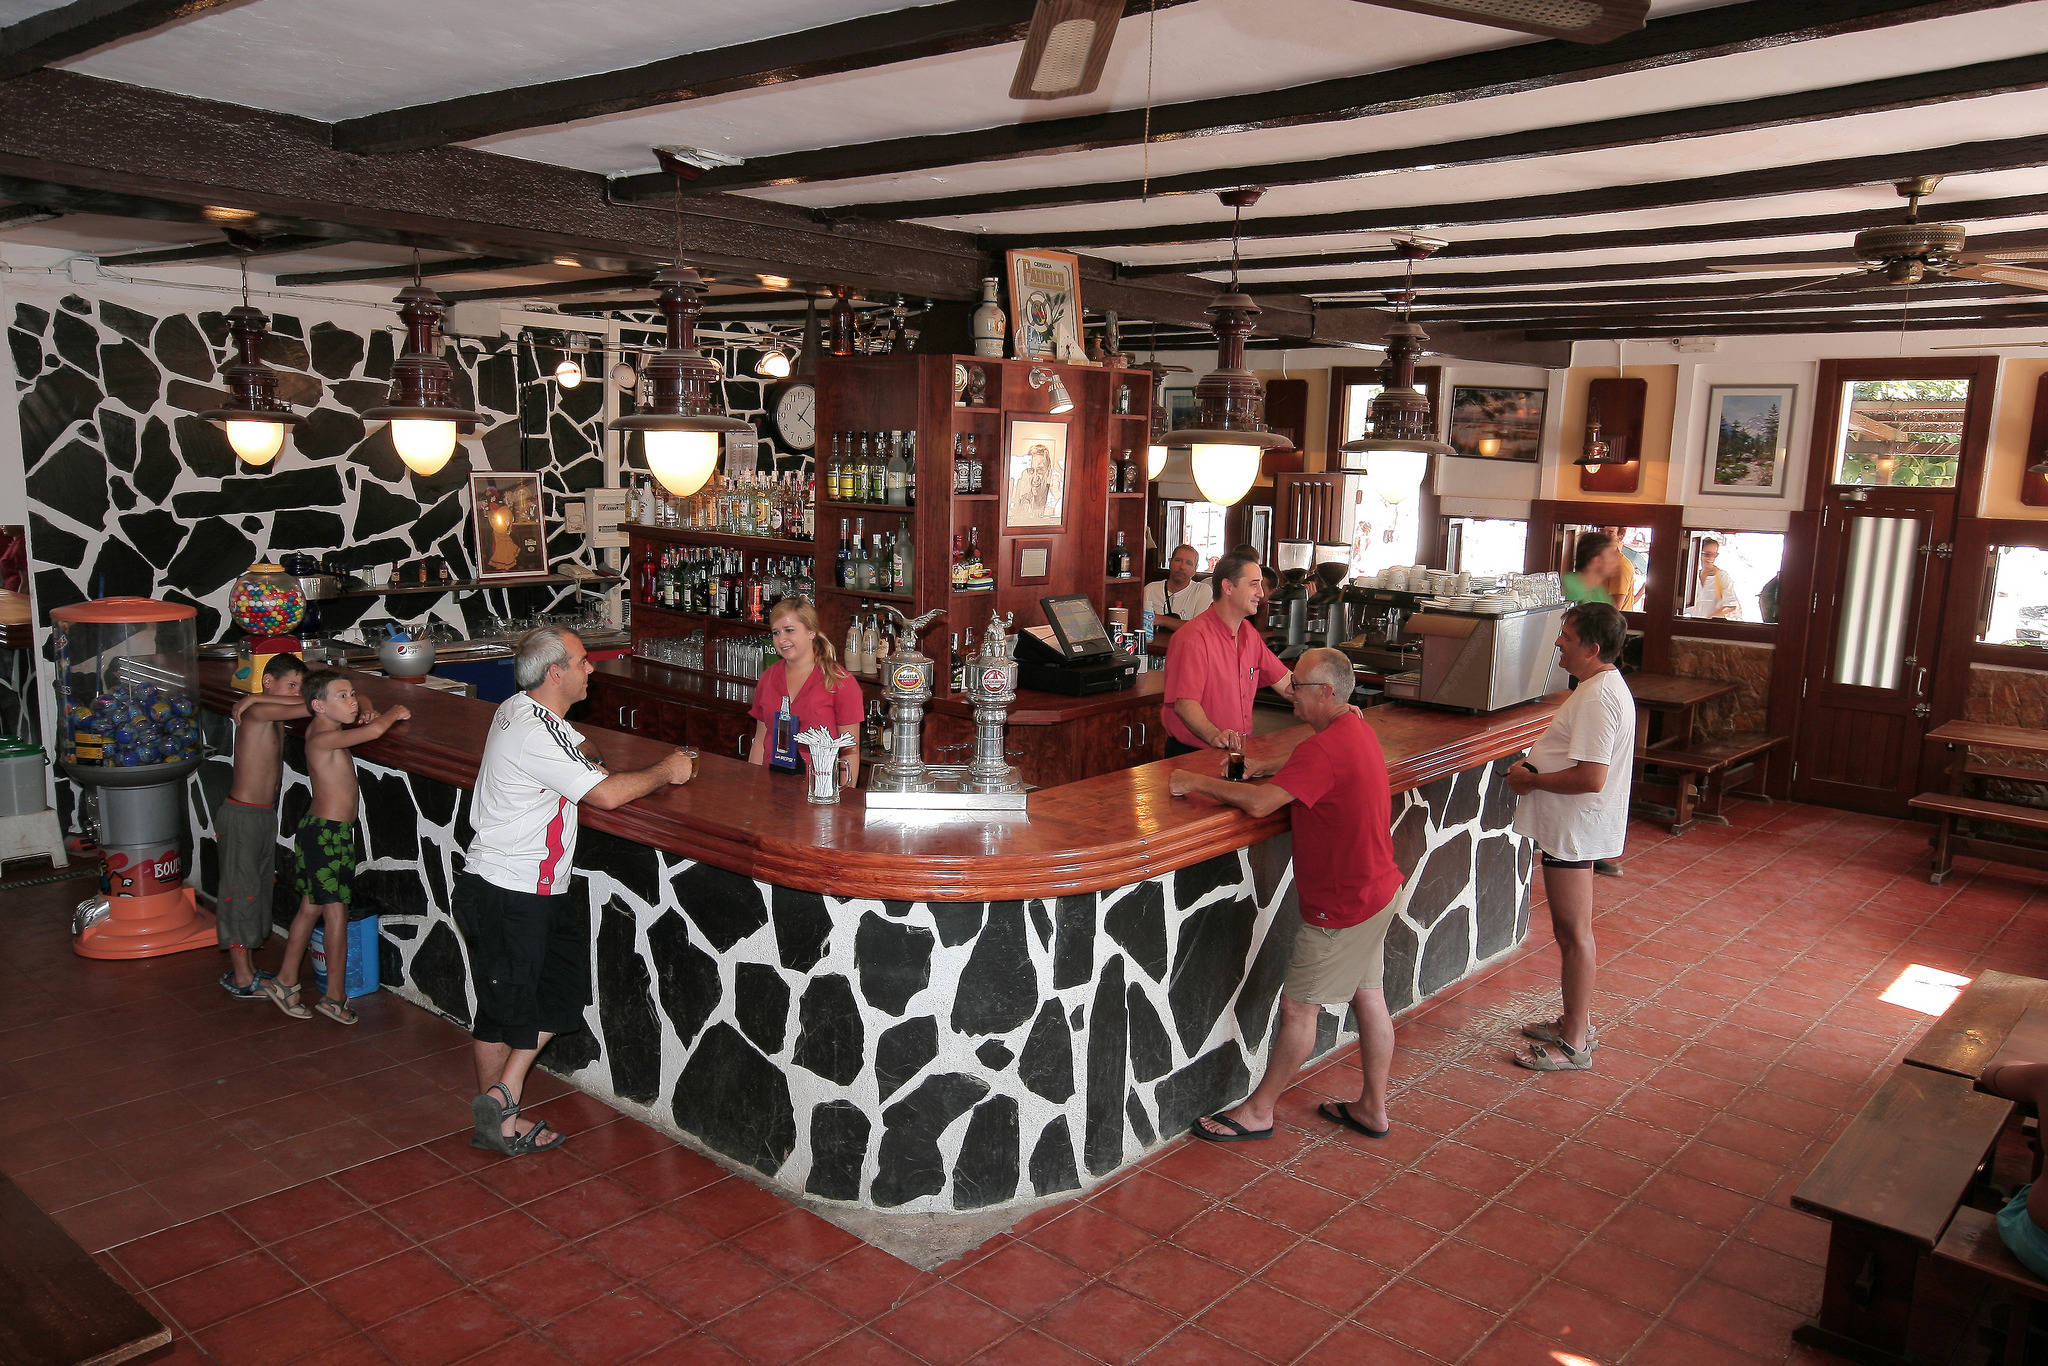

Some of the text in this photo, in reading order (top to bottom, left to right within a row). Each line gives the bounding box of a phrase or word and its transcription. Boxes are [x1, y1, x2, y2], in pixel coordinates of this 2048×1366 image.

[790, 394, 796, 402] 11
[797, 392, 805, 400] 12
[784, 403, 792, 411] 10
